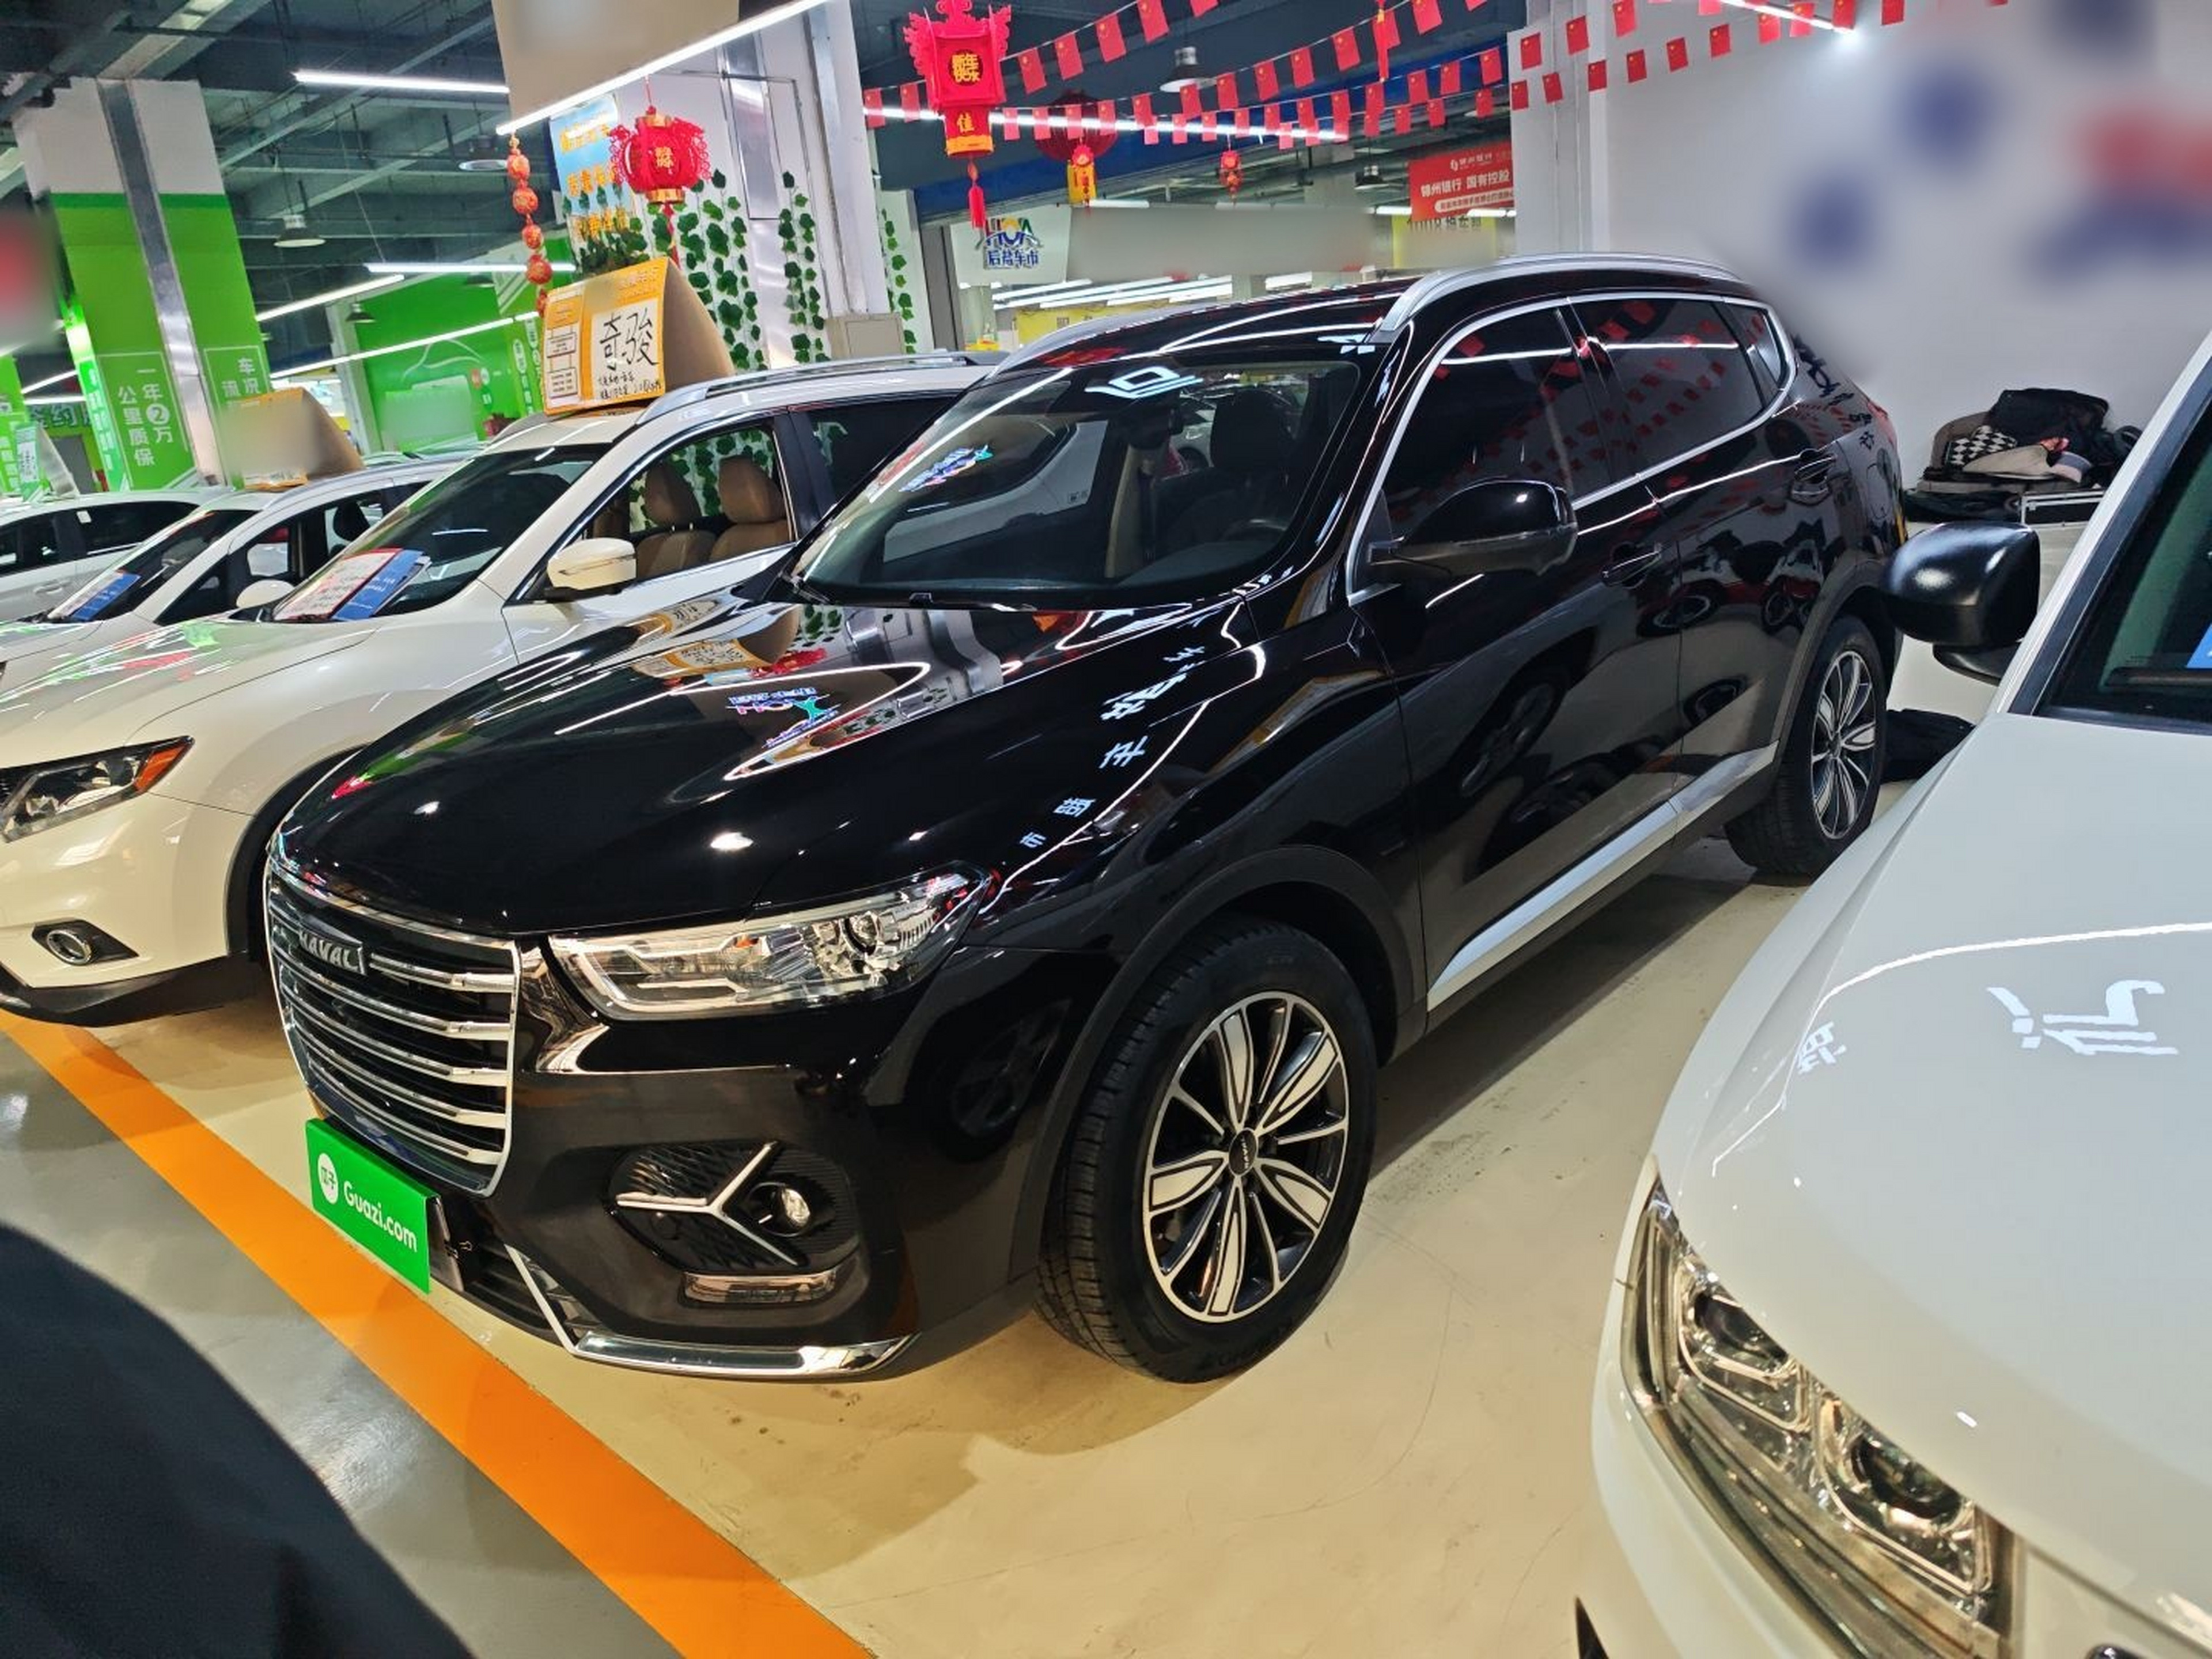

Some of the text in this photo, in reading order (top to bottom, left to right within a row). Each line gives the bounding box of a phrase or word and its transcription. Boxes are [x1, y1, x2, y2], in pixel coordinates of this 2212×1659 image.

[600, 308, 659, 372] 奇骏
[118, 385, 155, 467] 公里质保
[299, 930, 358, 971] HAVAL
[343, 1181, 418, 1253] Guazi.com
